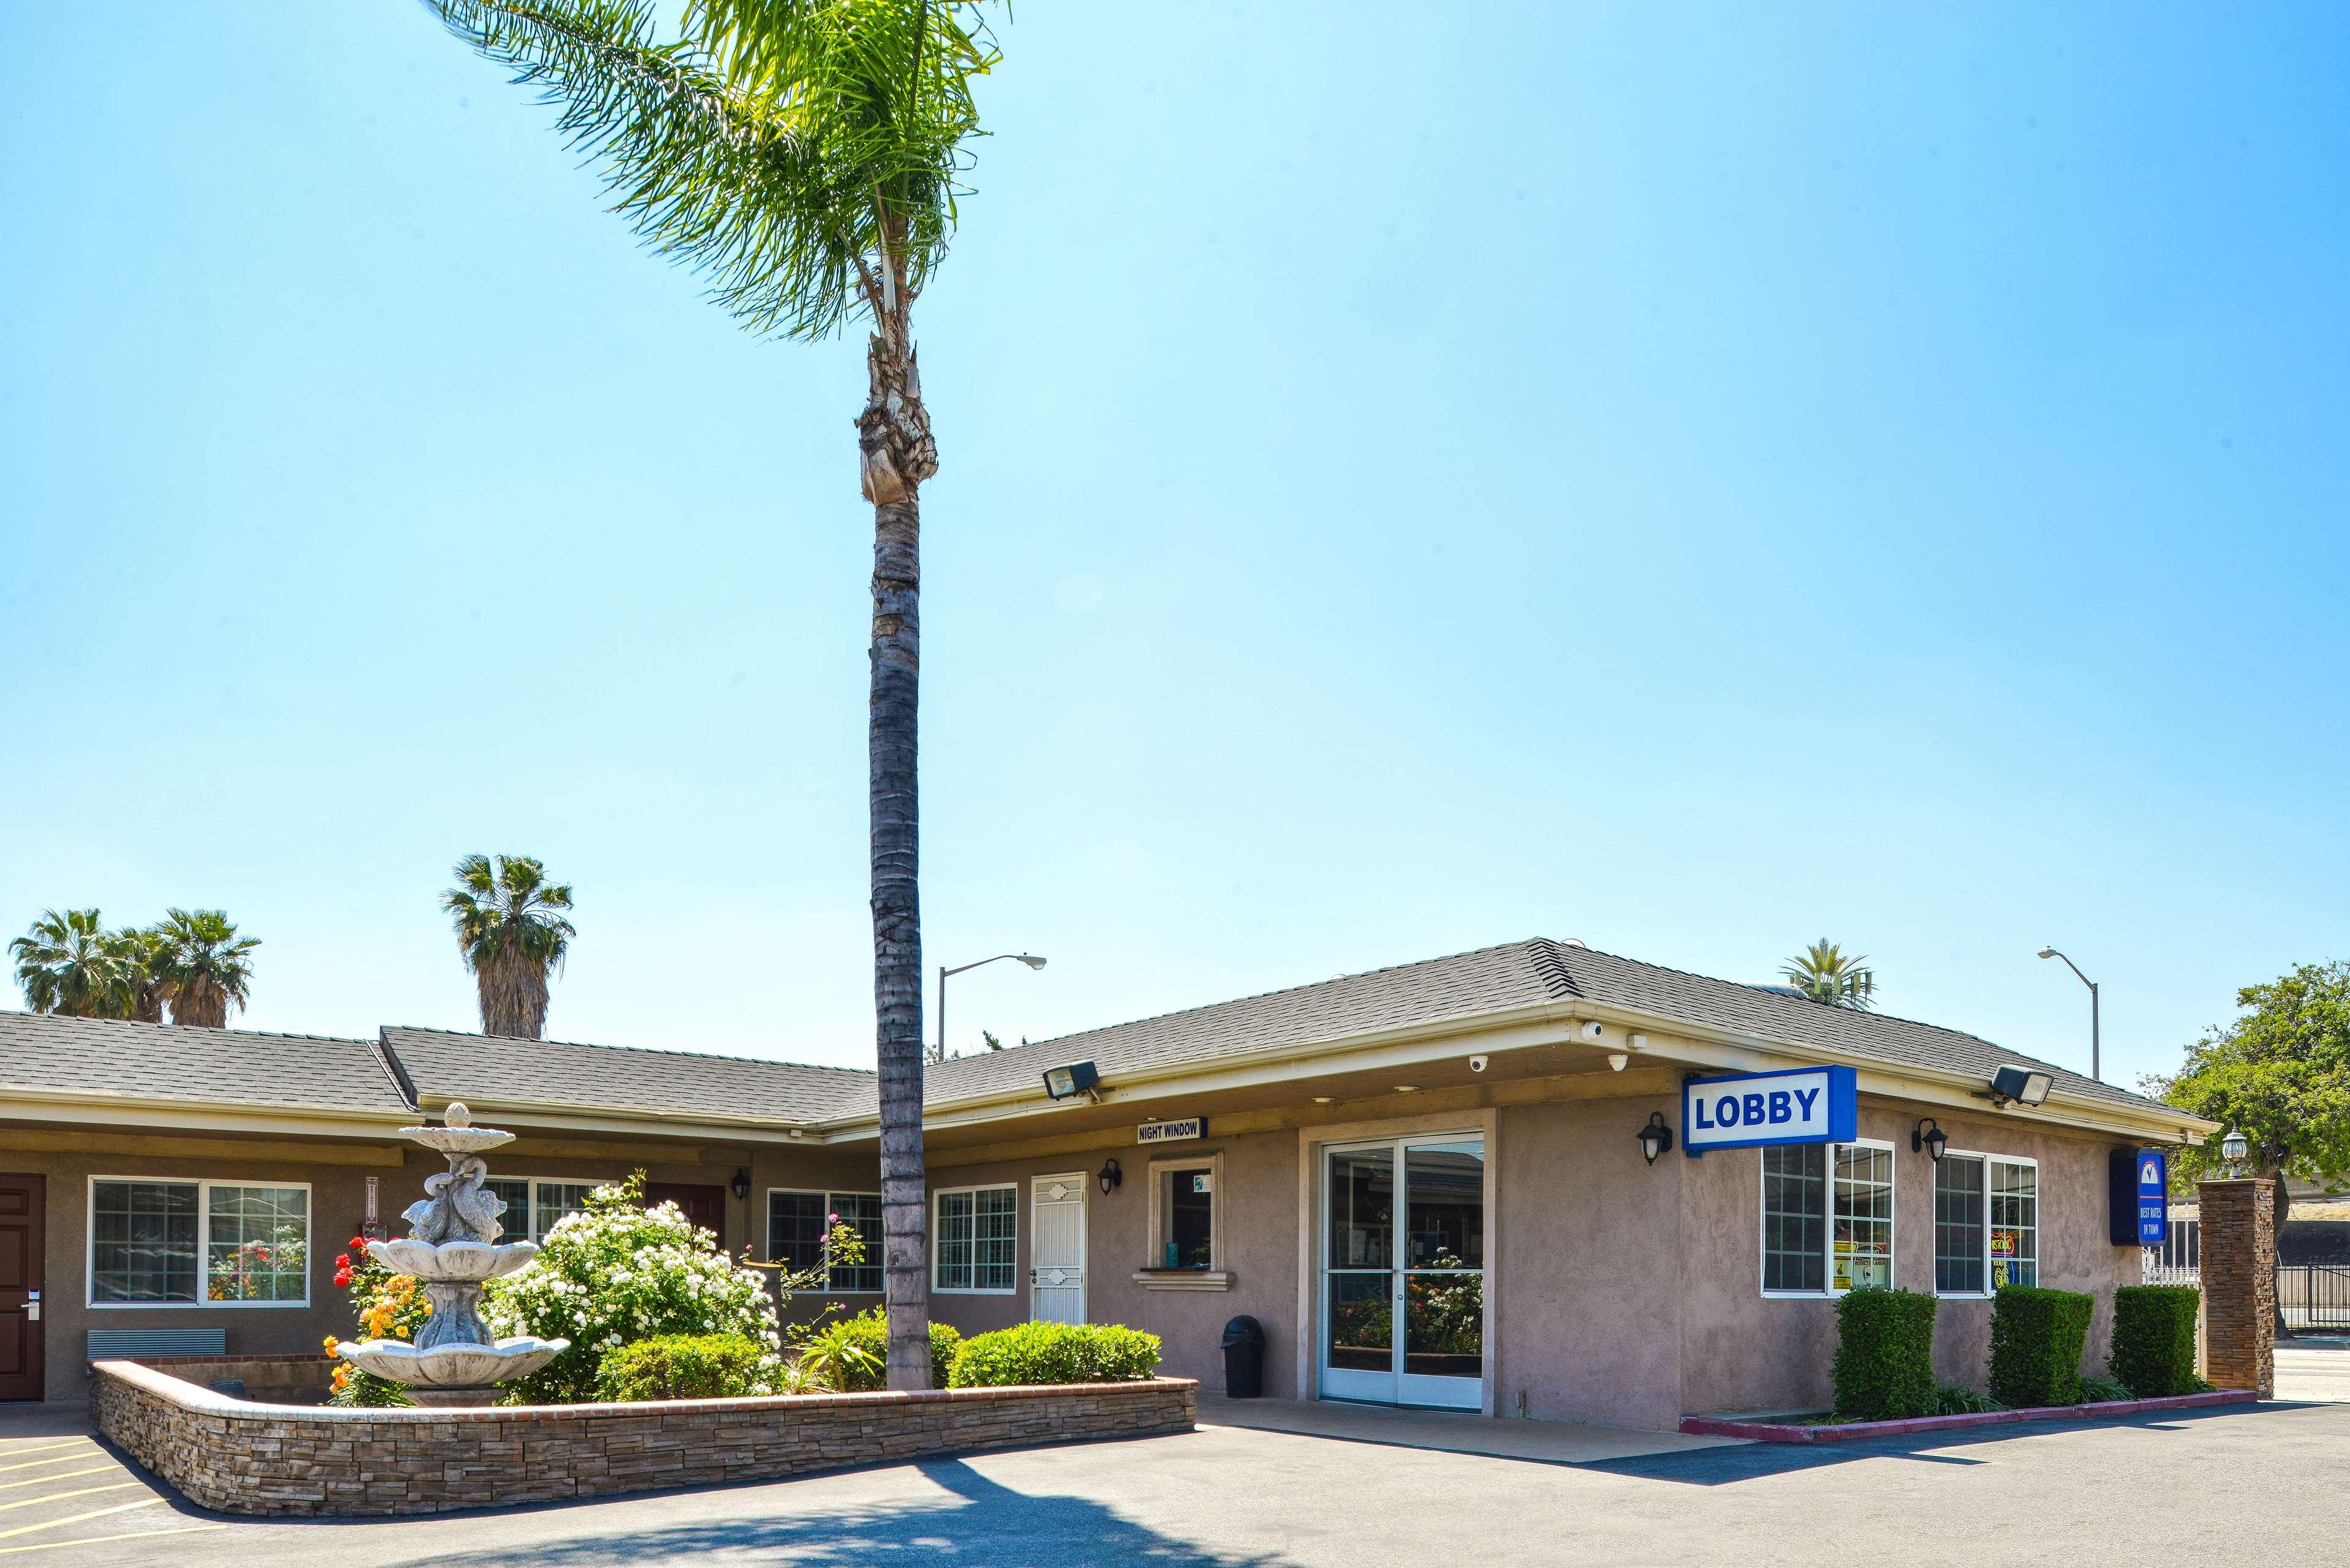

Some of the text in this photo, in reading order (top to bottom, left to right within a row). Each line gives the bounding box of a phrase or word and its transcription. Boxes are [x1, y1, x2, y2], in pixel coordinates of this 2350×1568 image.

[1696, 1088, 1820, 1129] LOBBY
[1139, 1122, 1197, 1140] NIGHT WINDOW
[2140, 1208, 2161, 1218] BEST RATES
[2144, 1224, 2158, 1235] IN TOWN
